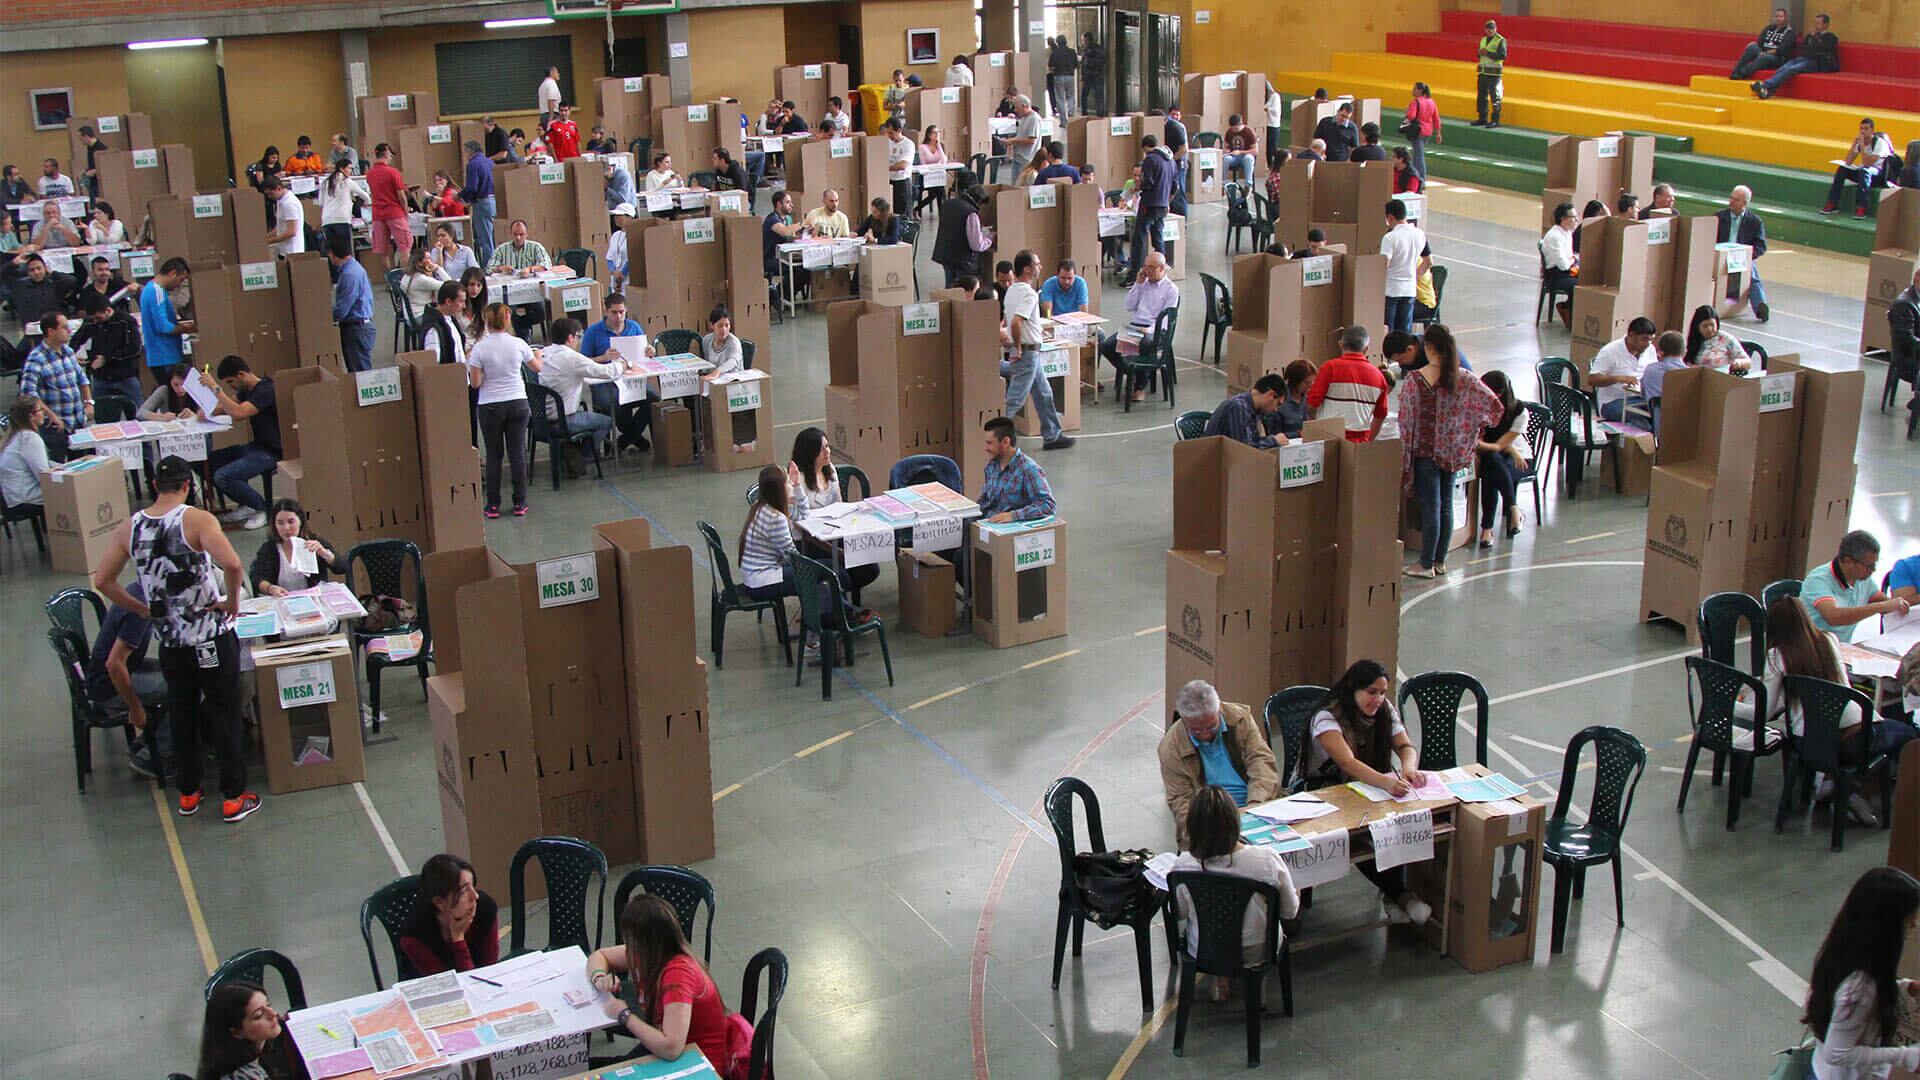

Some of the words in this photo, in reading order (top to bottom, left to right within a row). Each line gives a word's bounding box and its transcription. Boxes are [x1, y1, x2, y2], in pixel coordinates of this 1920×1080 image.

[1031, 196, 1044, 204] MESA
[685, 231, 703, 240] MESA
[244, 276, 264, 287] MESA
[266, 275, 275, 285] 20
[1304, 271, 1320, 281] MESA
[564, 300, 580, 309] MESA
[906, 319, 925, 330] MESA
[927, 317, 937, 328] 22
[361, 383, 385, 400] MESA
[387, 383, 398, 396] 21
[730, 398, 749, 408] MESA
[751, 396, 759, 404] 19
[1760, 391, 1782, 406] MESA
[1282, 464, 1309, 481] MESA
[1311, 461, 1321, 476] 29
[1017, 551, 1040, 565] MESA
[1042, 549, 1052, 560] 22
[543, 582, 576, 600] MESA
[580, 577, 594, 594] 30
[283, 684, 314, 700] MESA
[317, 681, 331, 697] 21
